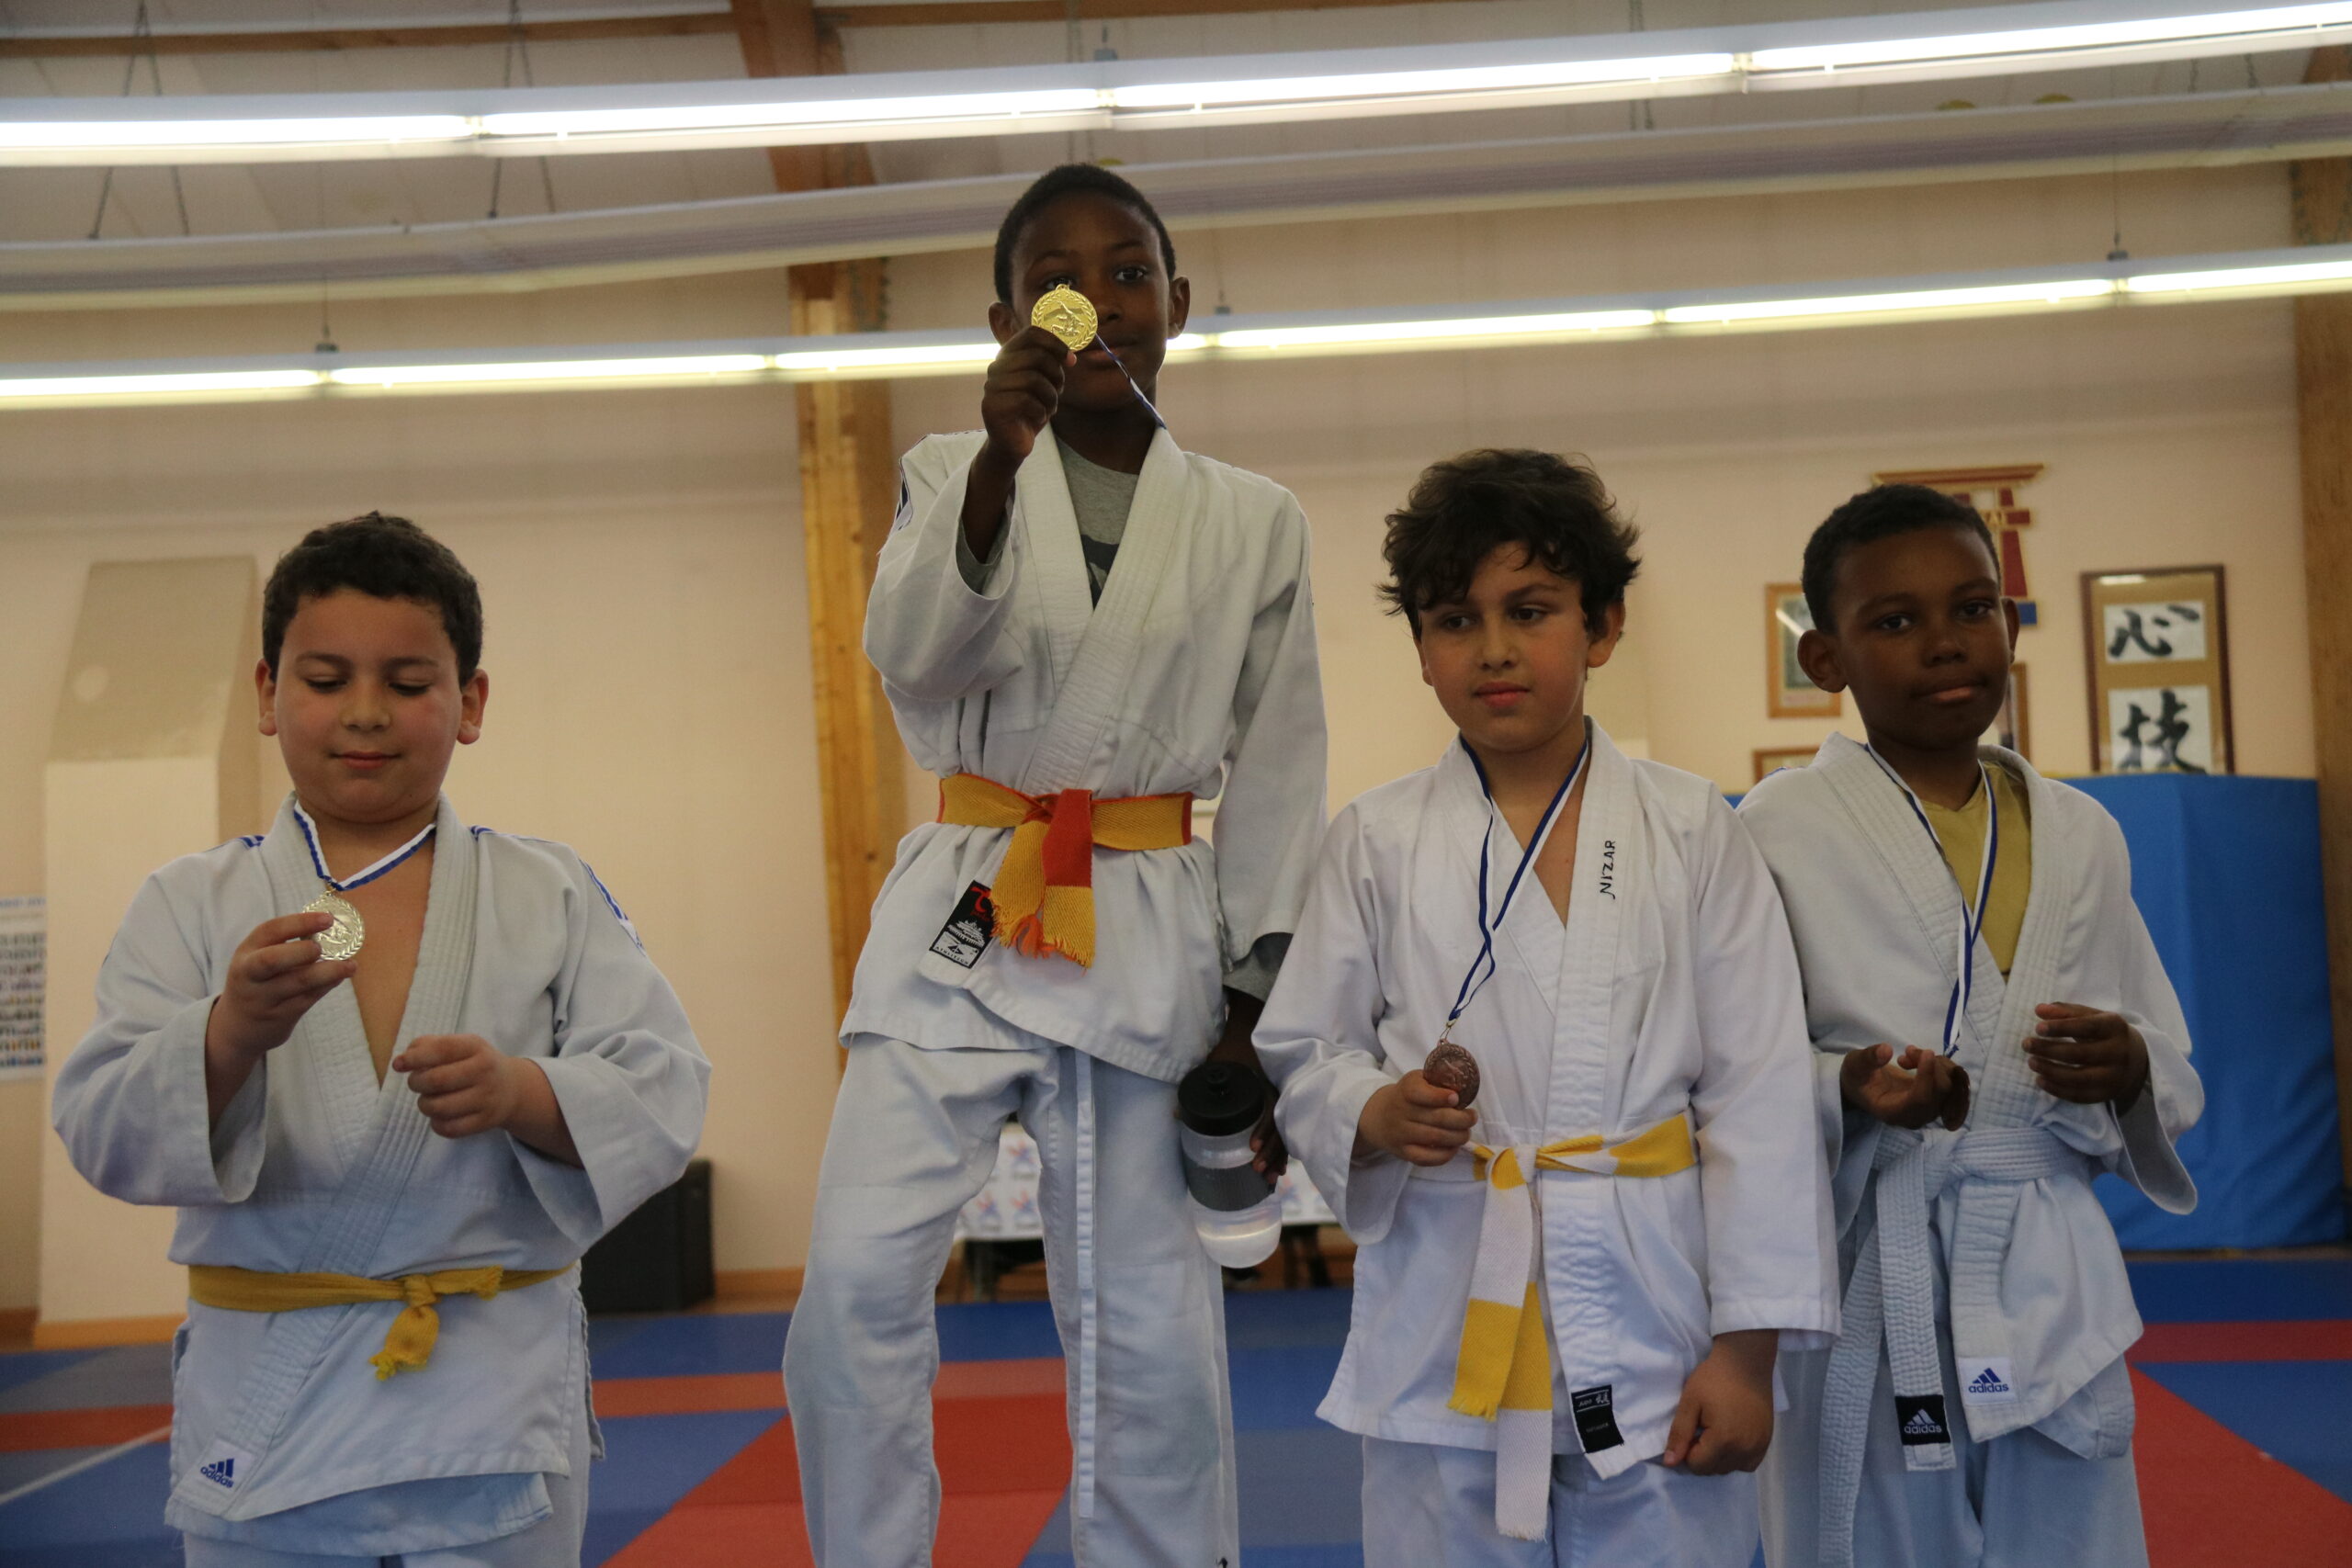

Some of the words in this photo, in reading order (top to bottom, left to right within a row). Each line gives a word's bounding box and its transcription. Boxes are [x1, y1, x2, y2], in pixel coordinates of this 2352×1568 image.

[1600, 840, 1616, 899] NIZAR
[1968, 1382, 2009, 1393] adidas
[1904, 1423, 1942, 1434] adidas
[200, 1466, 234, 1488] adidas
